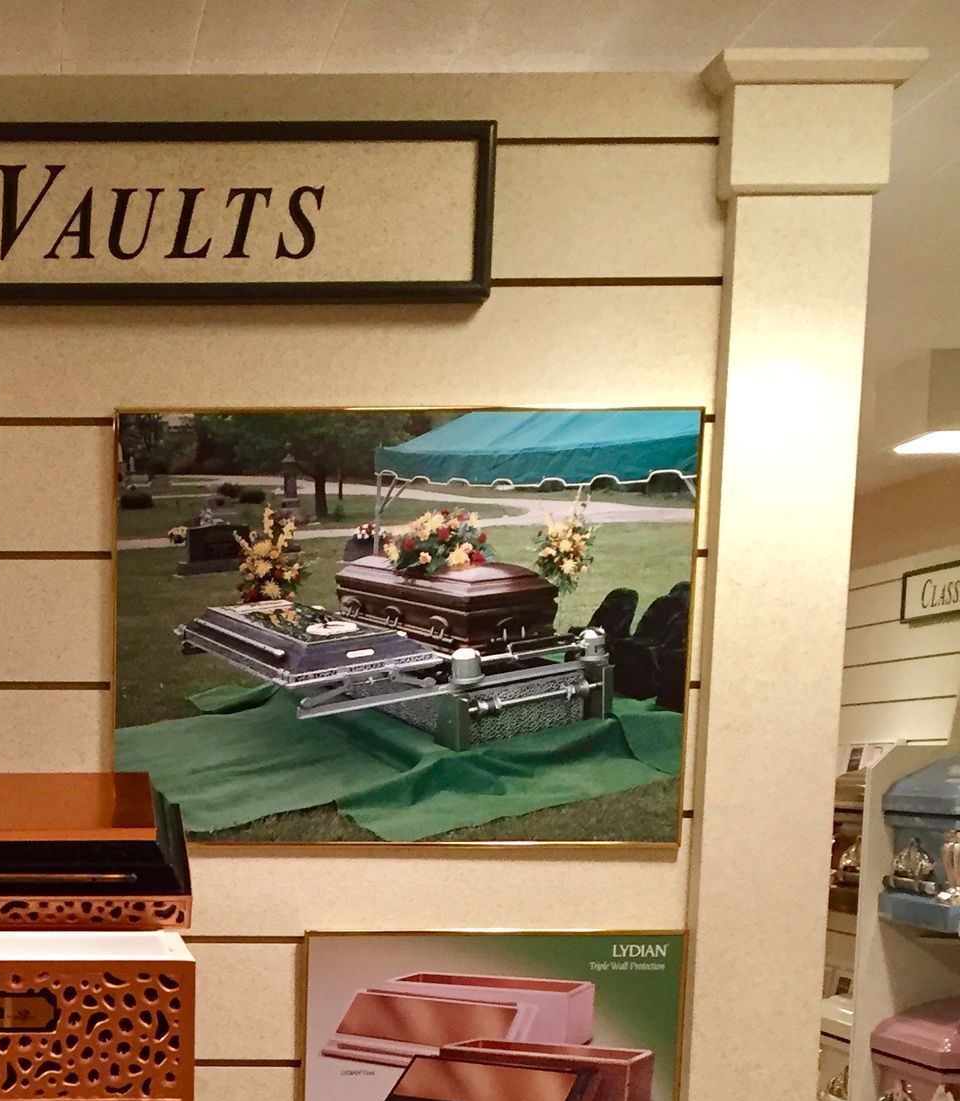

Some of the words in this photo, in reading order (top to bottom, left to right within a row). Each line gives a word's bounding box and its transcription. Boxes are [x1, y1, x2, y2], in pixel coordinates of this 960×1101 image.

[612, 944, 667, 957] LYDIAN
[589, 961, 609, 971] Triple
[610, 961, 629, 970] Wall
[629, 962, 665, 970] Protection
